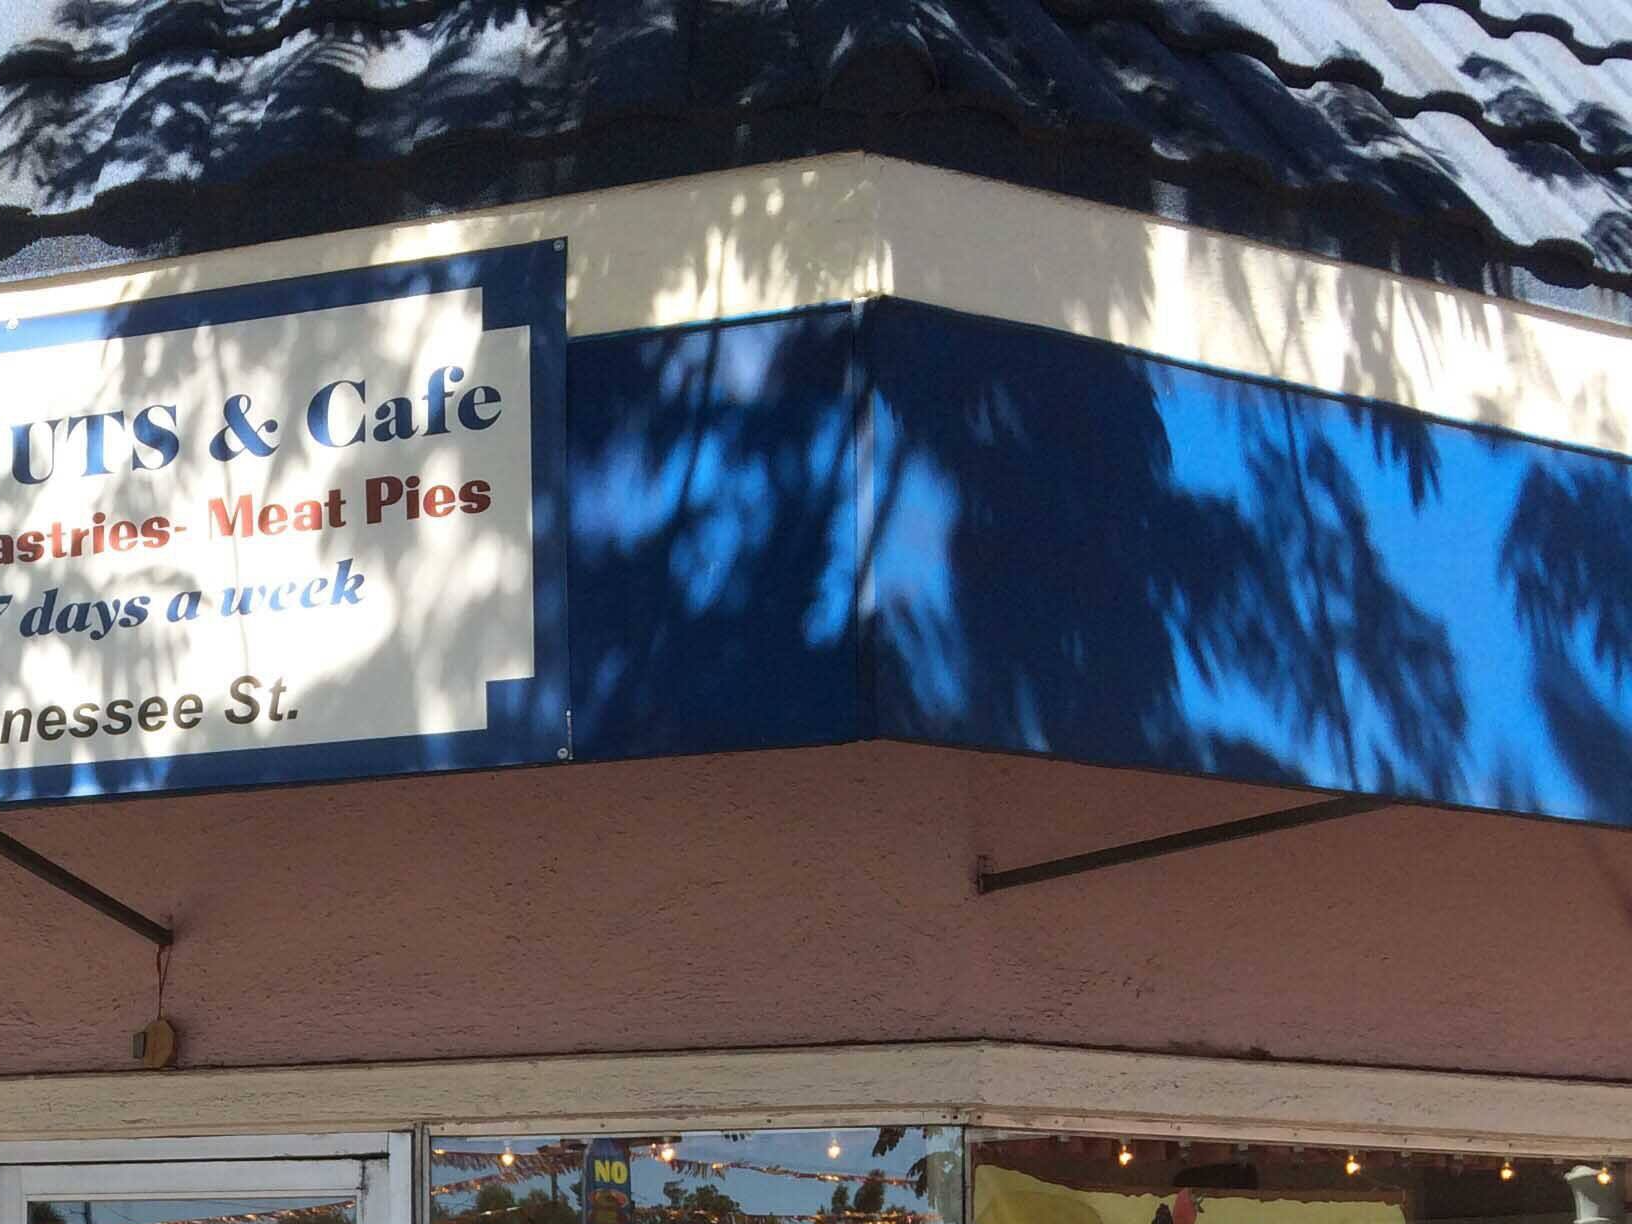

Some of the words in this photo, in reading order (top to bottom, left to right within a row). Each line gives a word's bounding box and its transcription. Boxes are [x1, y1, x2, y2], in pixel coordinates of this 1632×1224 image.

[209, 394, 280, 461] &
[307, 366, 502, 447] Cafe
[208, 489, 346, 540] Meat
[365, 476, 492, 525] Pies
[19, 587, 150, 641] days
[166, 587, 200, 621] a
[221, 558, 366, 617] week
[225, 676, 300, 725] St.
[594, 1159, 629, 1185] NO
